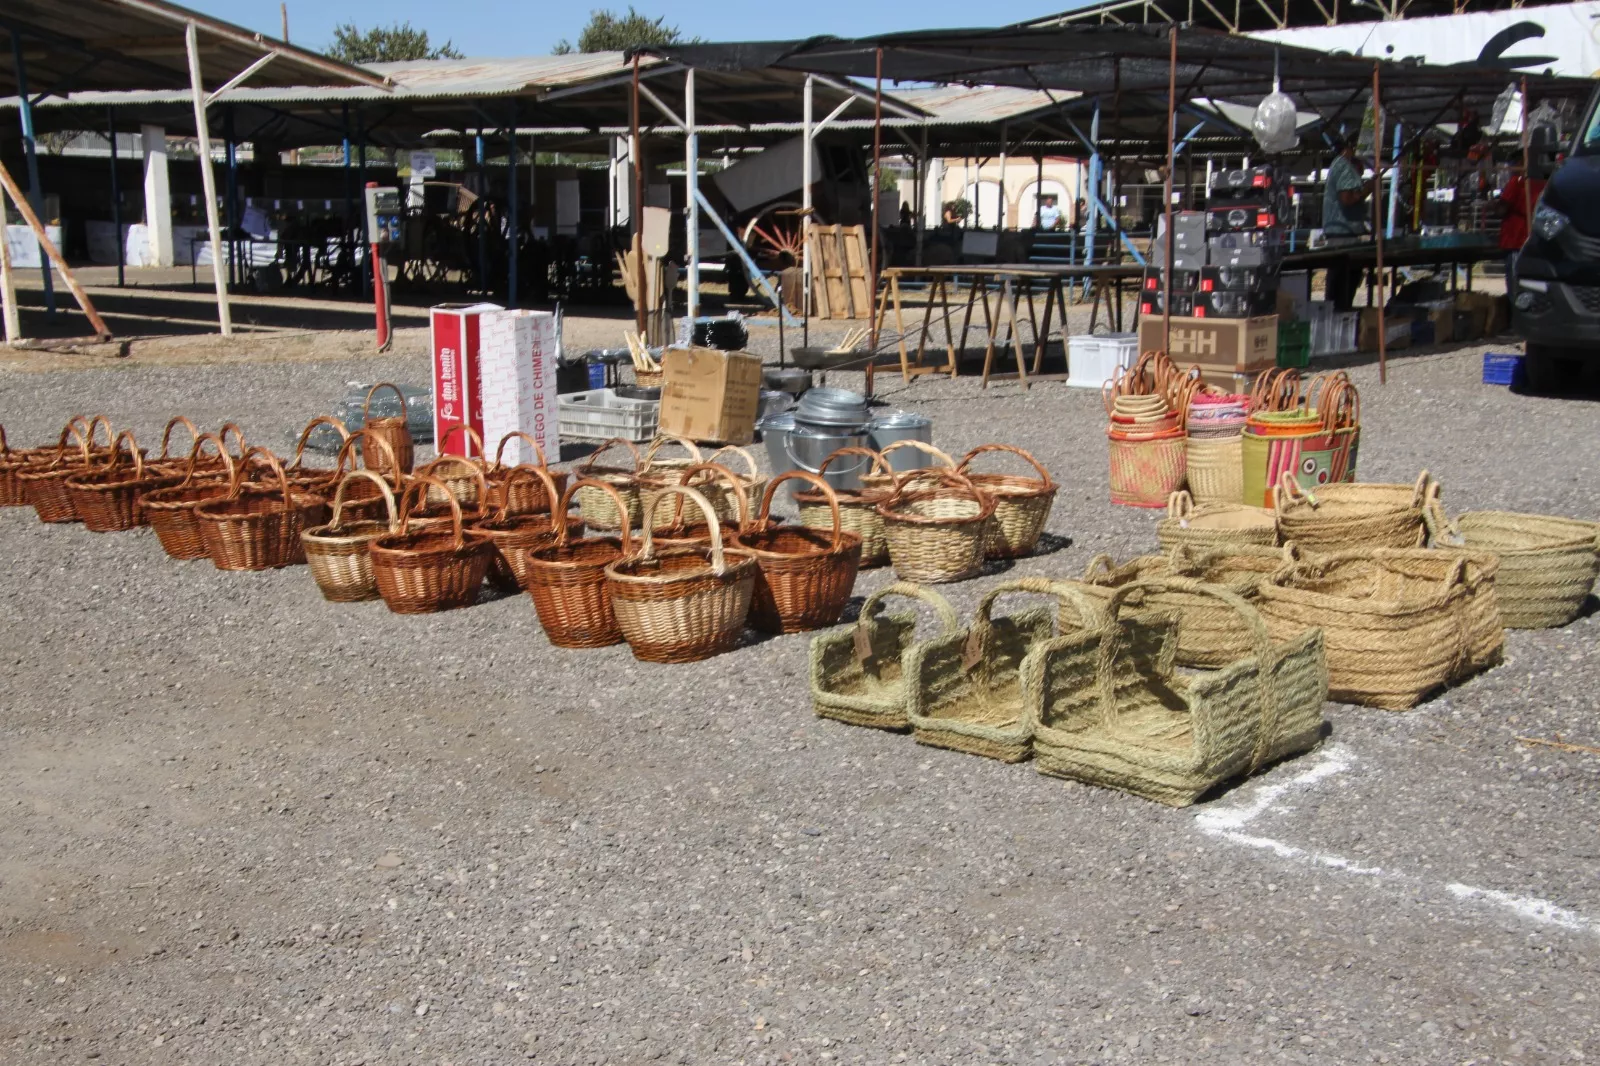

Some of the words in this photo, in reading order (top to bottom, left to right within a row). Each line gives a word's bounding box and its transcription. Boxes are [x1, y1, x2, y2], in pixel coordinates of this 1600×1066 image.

[440, 347, 451, 379] benito
[441, 380, 451, 401] don
[534, 392, 544, 409] DE
